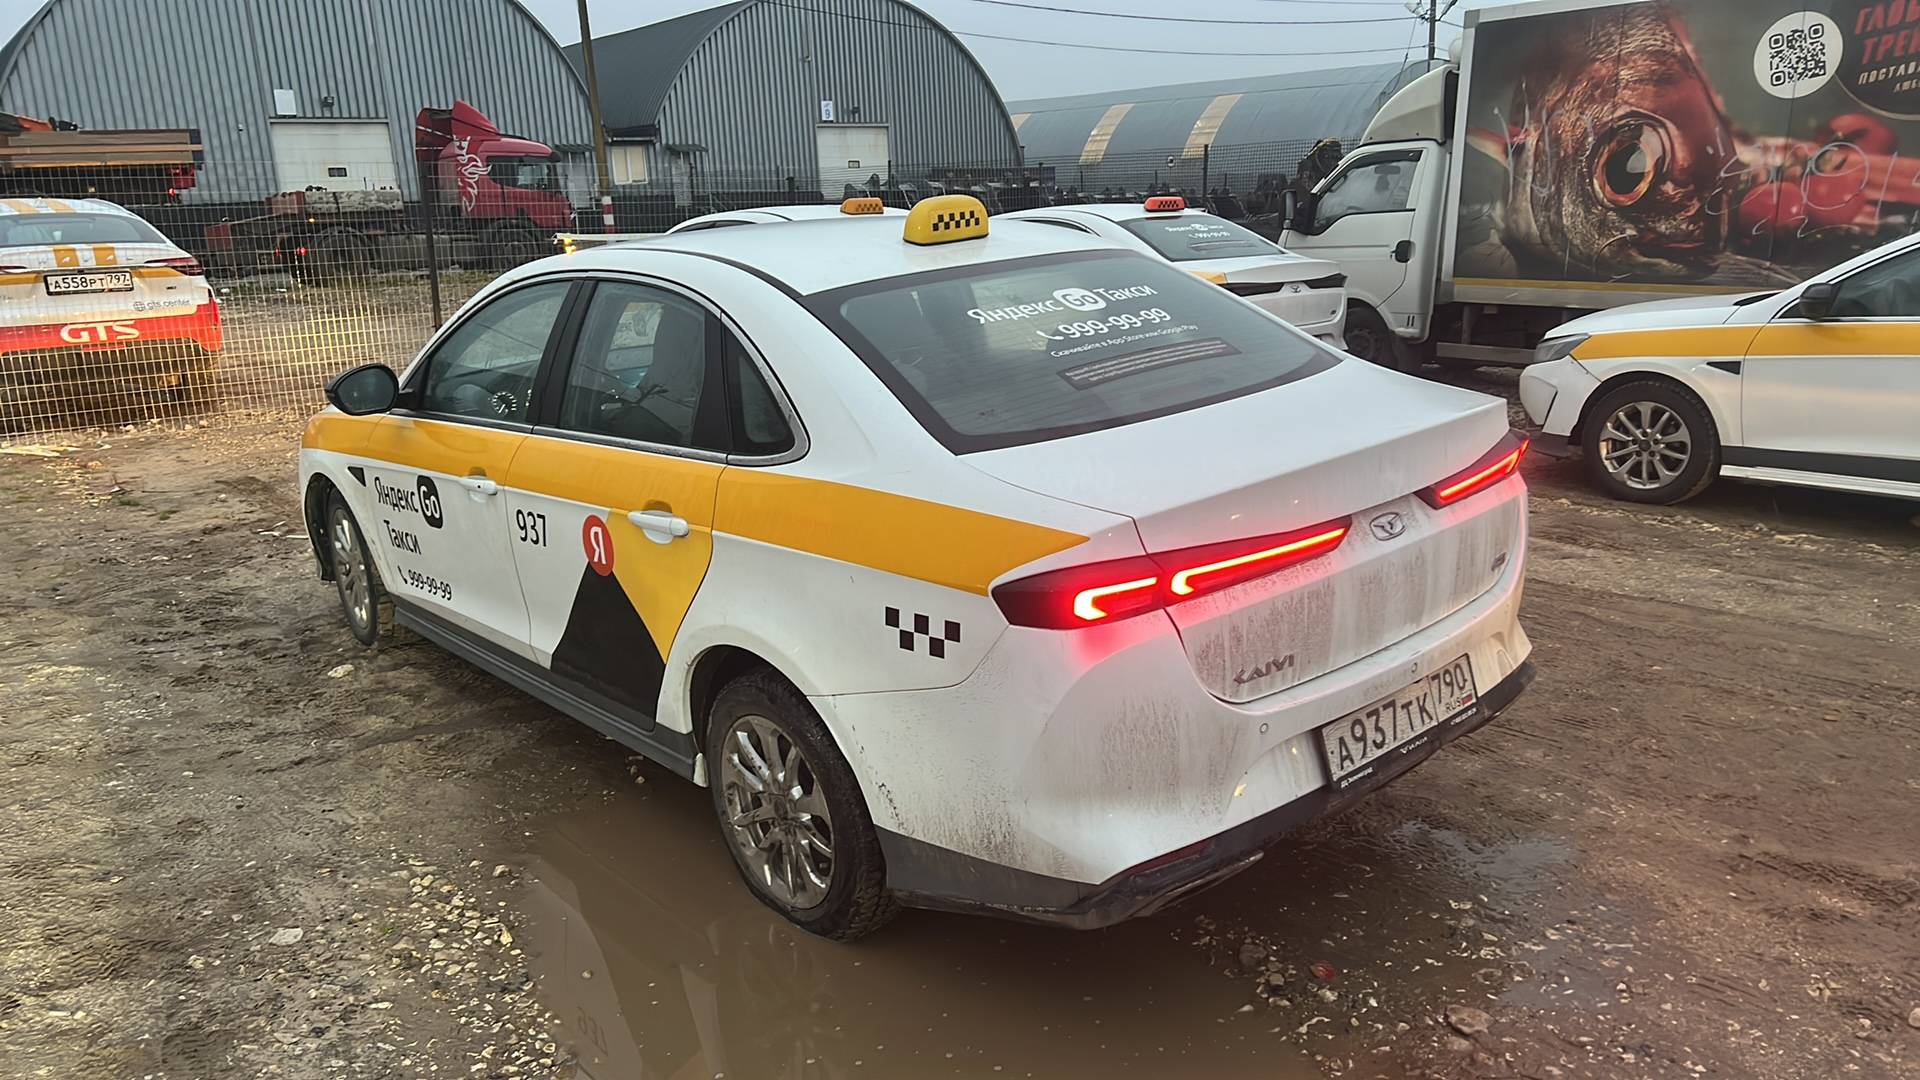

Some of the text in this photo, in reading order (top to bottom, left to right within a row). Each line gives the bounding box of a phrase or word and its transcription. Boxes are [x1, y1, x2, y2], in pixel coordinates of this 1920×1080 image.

[1858, 61, 1920, 85] ПОСТАВ
[54, 274, 127, 290] А558РТ 797
[967, 284, 1159, 325] Яндекс Go Такси
[60, 320, 140, 343] GTS
[1057, 307, 1171, 339] 999-99-99
[374, 476, 442, 522] Яндекс Go
[383, 520, 421, 555] Такси
[516, 509, 547, 547] 937
[590, 526, 607, 565] Я
[408, 569, 452, 601] 999-99-99
[1338, 663, 1468, 771] А937ТК 790
[1446, 696, 1462, 713] RUS
